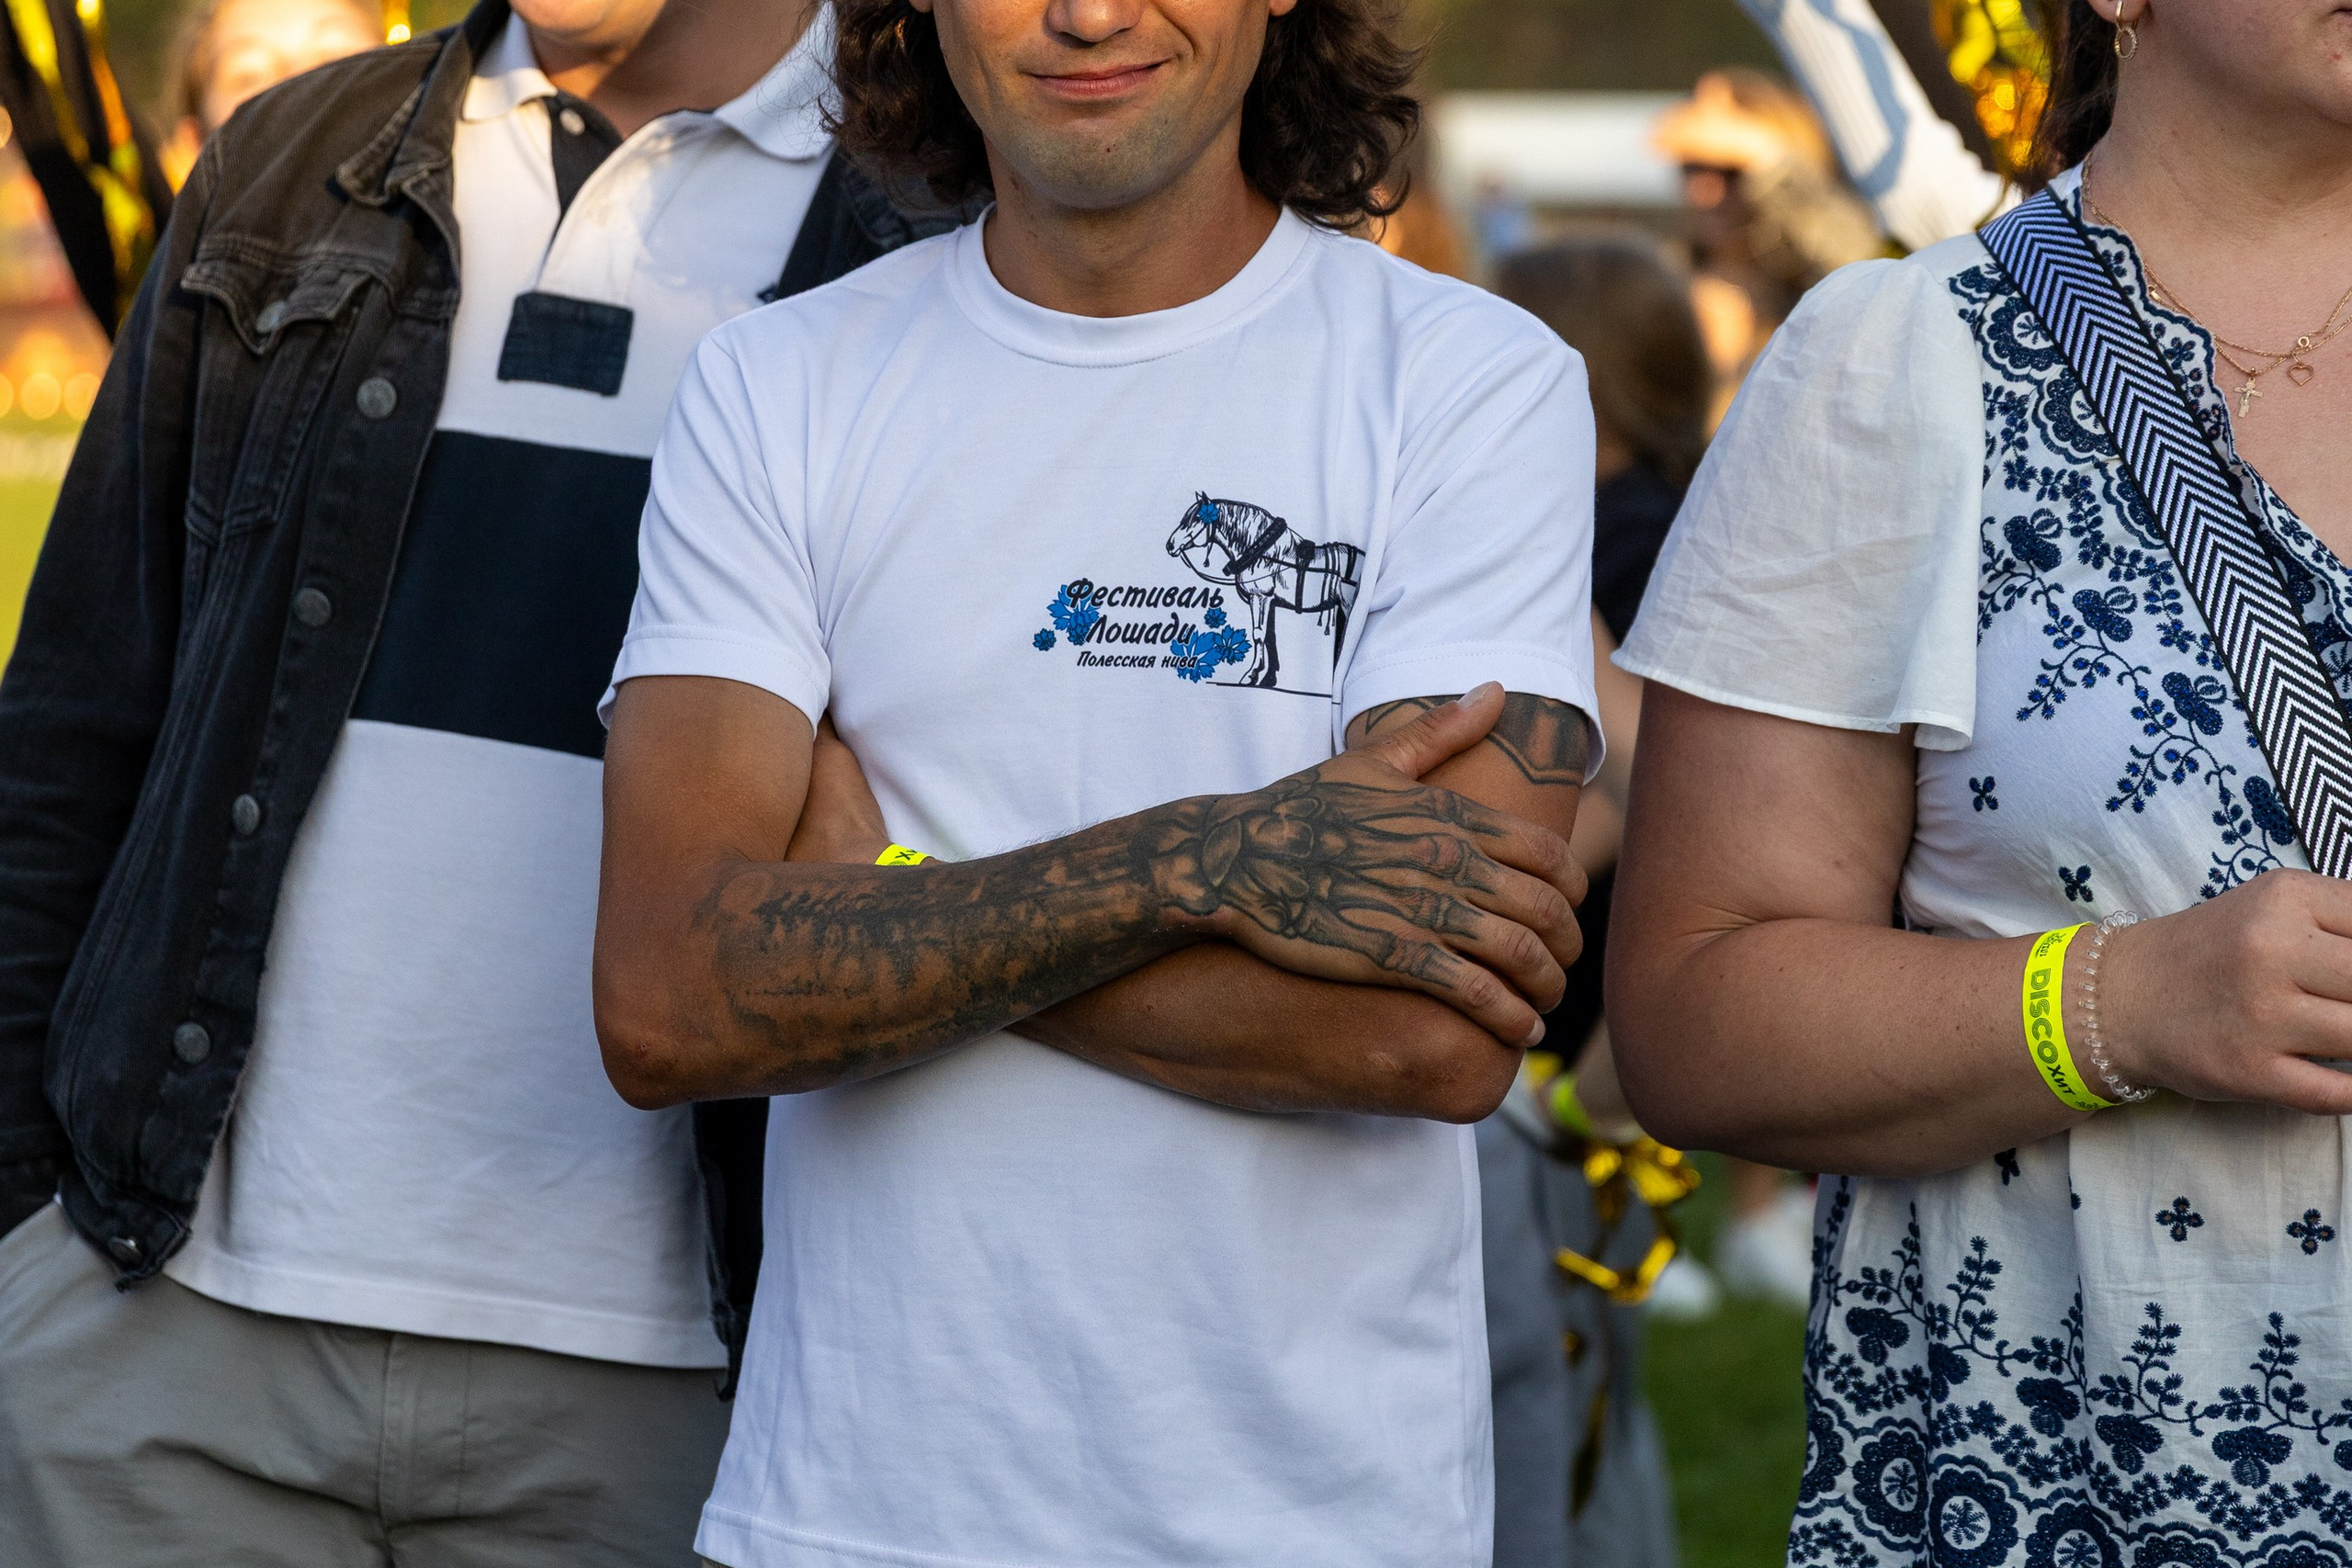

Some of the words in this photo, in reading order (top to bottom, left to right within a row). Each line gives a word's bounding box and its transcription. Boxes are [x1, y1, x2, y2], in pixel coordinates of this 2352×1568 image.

[1066, 578, 1225, 608] Фестиваль
[1085, 612, 1196, 645] Лошади
[1076, 650, 1157, 668] Полесская
[1161, 654, 1198, 669] нива
